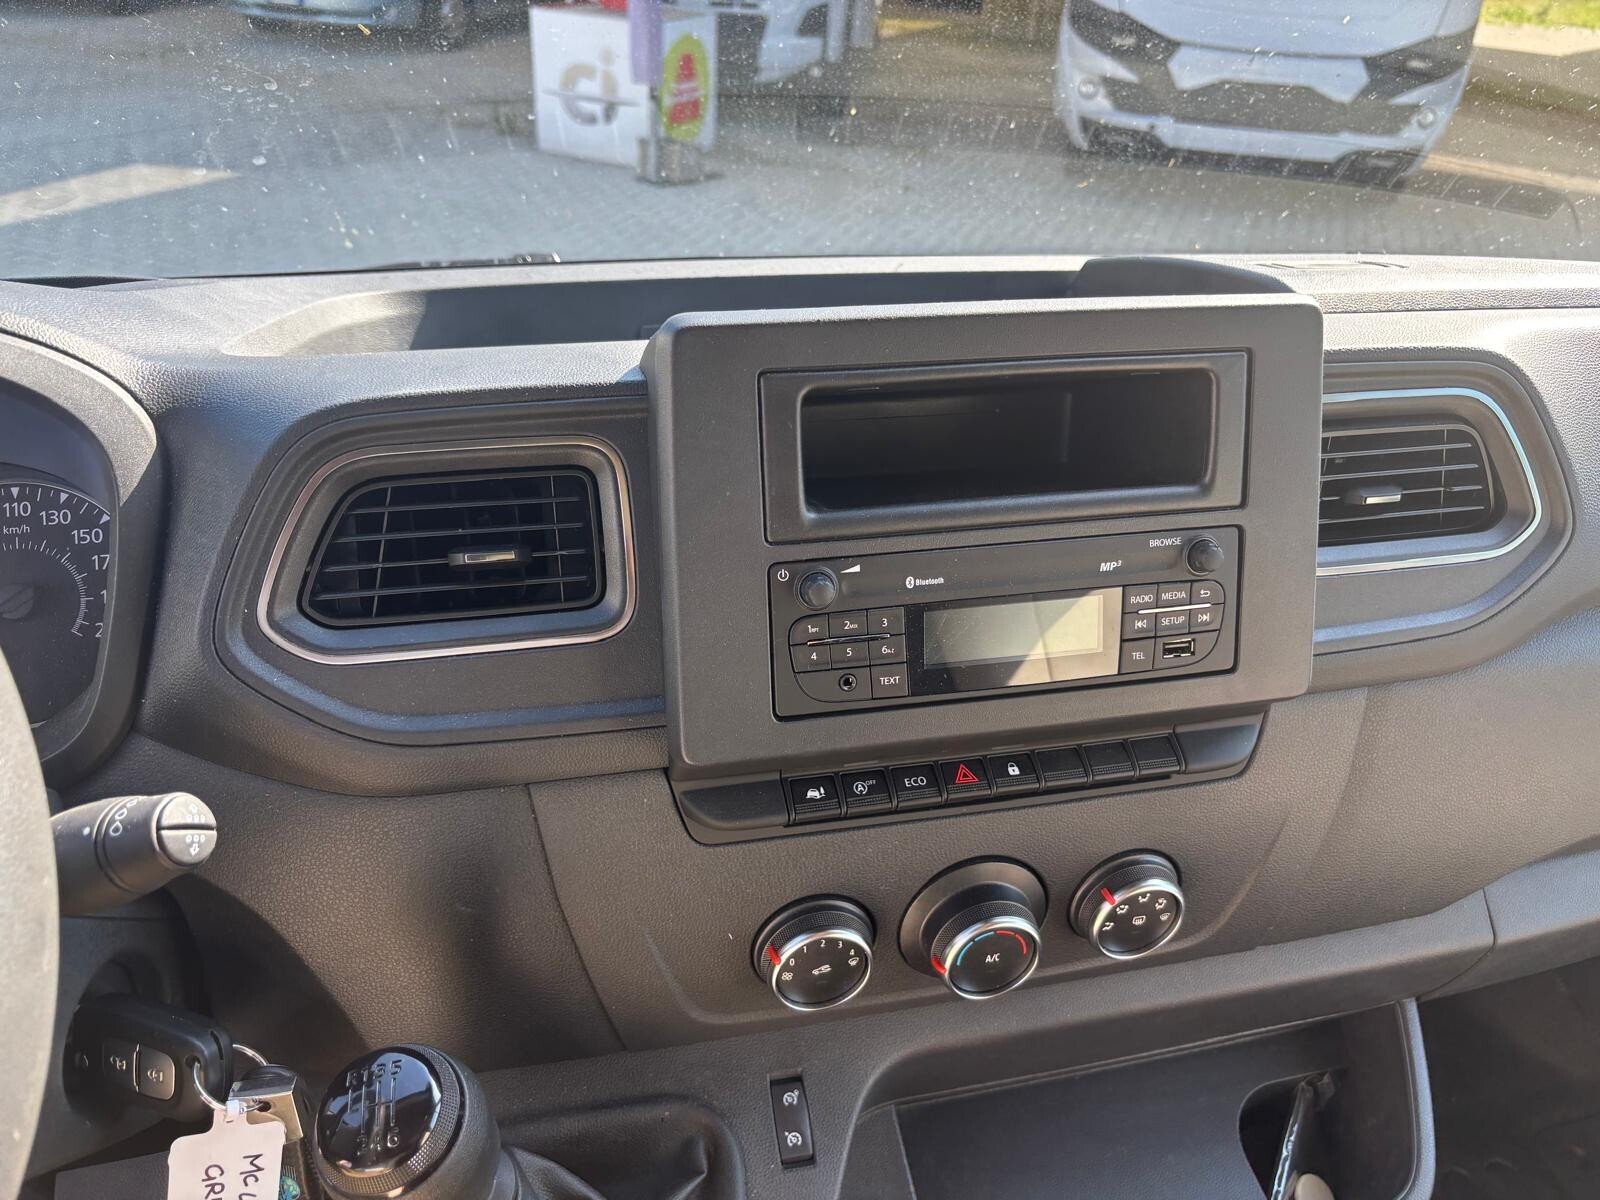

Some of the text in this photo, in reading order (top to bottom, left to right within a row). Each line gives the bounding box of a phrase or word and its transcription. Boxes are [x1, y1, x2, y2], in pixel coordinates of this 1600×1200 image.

[3, 501, 32, 517] 110
[39, 509, 72, 526] 130
[3, 524, 31, 535] km/h
[71, 528, 104, 545] 150
[1149, 537, 1182, 548] BROWSE
[1100, 560, 1122, 572] MP3
[915, 576, 945, 587] Bluetooth
[1130, 594, 1154, 604] RADIO
[1161, 591, 1186, 601] MEDIA
[882, 618, 888, 627] 3
[1161, 615, 1185, 626] SETUP
[811, 652, 817, 660] 4
[846, 648, 852, 656] 5
[1132, 652, 1145, 660] TEL
[879, 676, 901, 685] TEXT
[904, 776, 927, 787] ECO
[820, 939, 826, 948] 2
[837, 940, 843, 949] 3
[803, 945, 808, 954] 1
[849, 948, 855, 956] 4
[789, 958, 795, 966] 0
[985, 952, 1000, 964] A/C
[389, 1059, 403, 1076] 5
[387, 1127, 400, 1148] 6
[201, 1163, 225, 1200] GR
